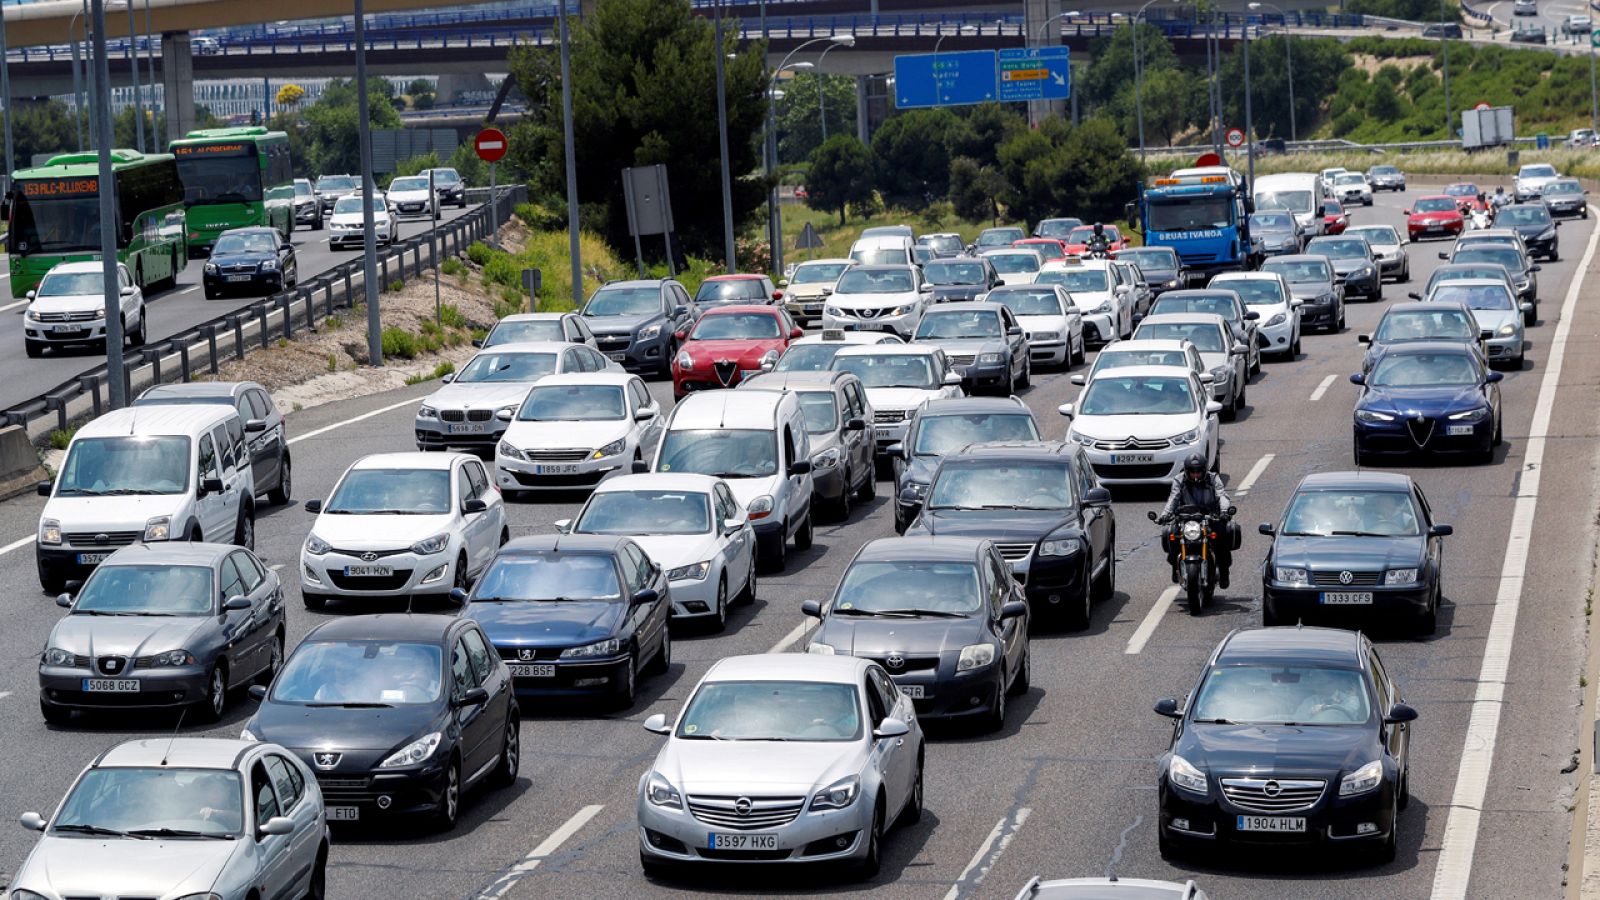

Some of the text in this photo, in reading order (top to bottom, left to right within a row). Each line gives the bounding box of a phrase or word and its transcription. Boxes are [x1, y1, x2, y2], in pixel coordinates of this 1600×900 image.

[542, 465, 560, 474] 1859
[350, 566, 389, 576] 9041 HZN
[1327, 593, 1370, 602] 1333 CFS
[508, 665, 552, 676] 228 BSF
[89, 680, 137, 691] 5068 GCZ
[1247, 817, 1303, 830] 1904 HLM
[716, 835, 775, 848] 3597 HXG
